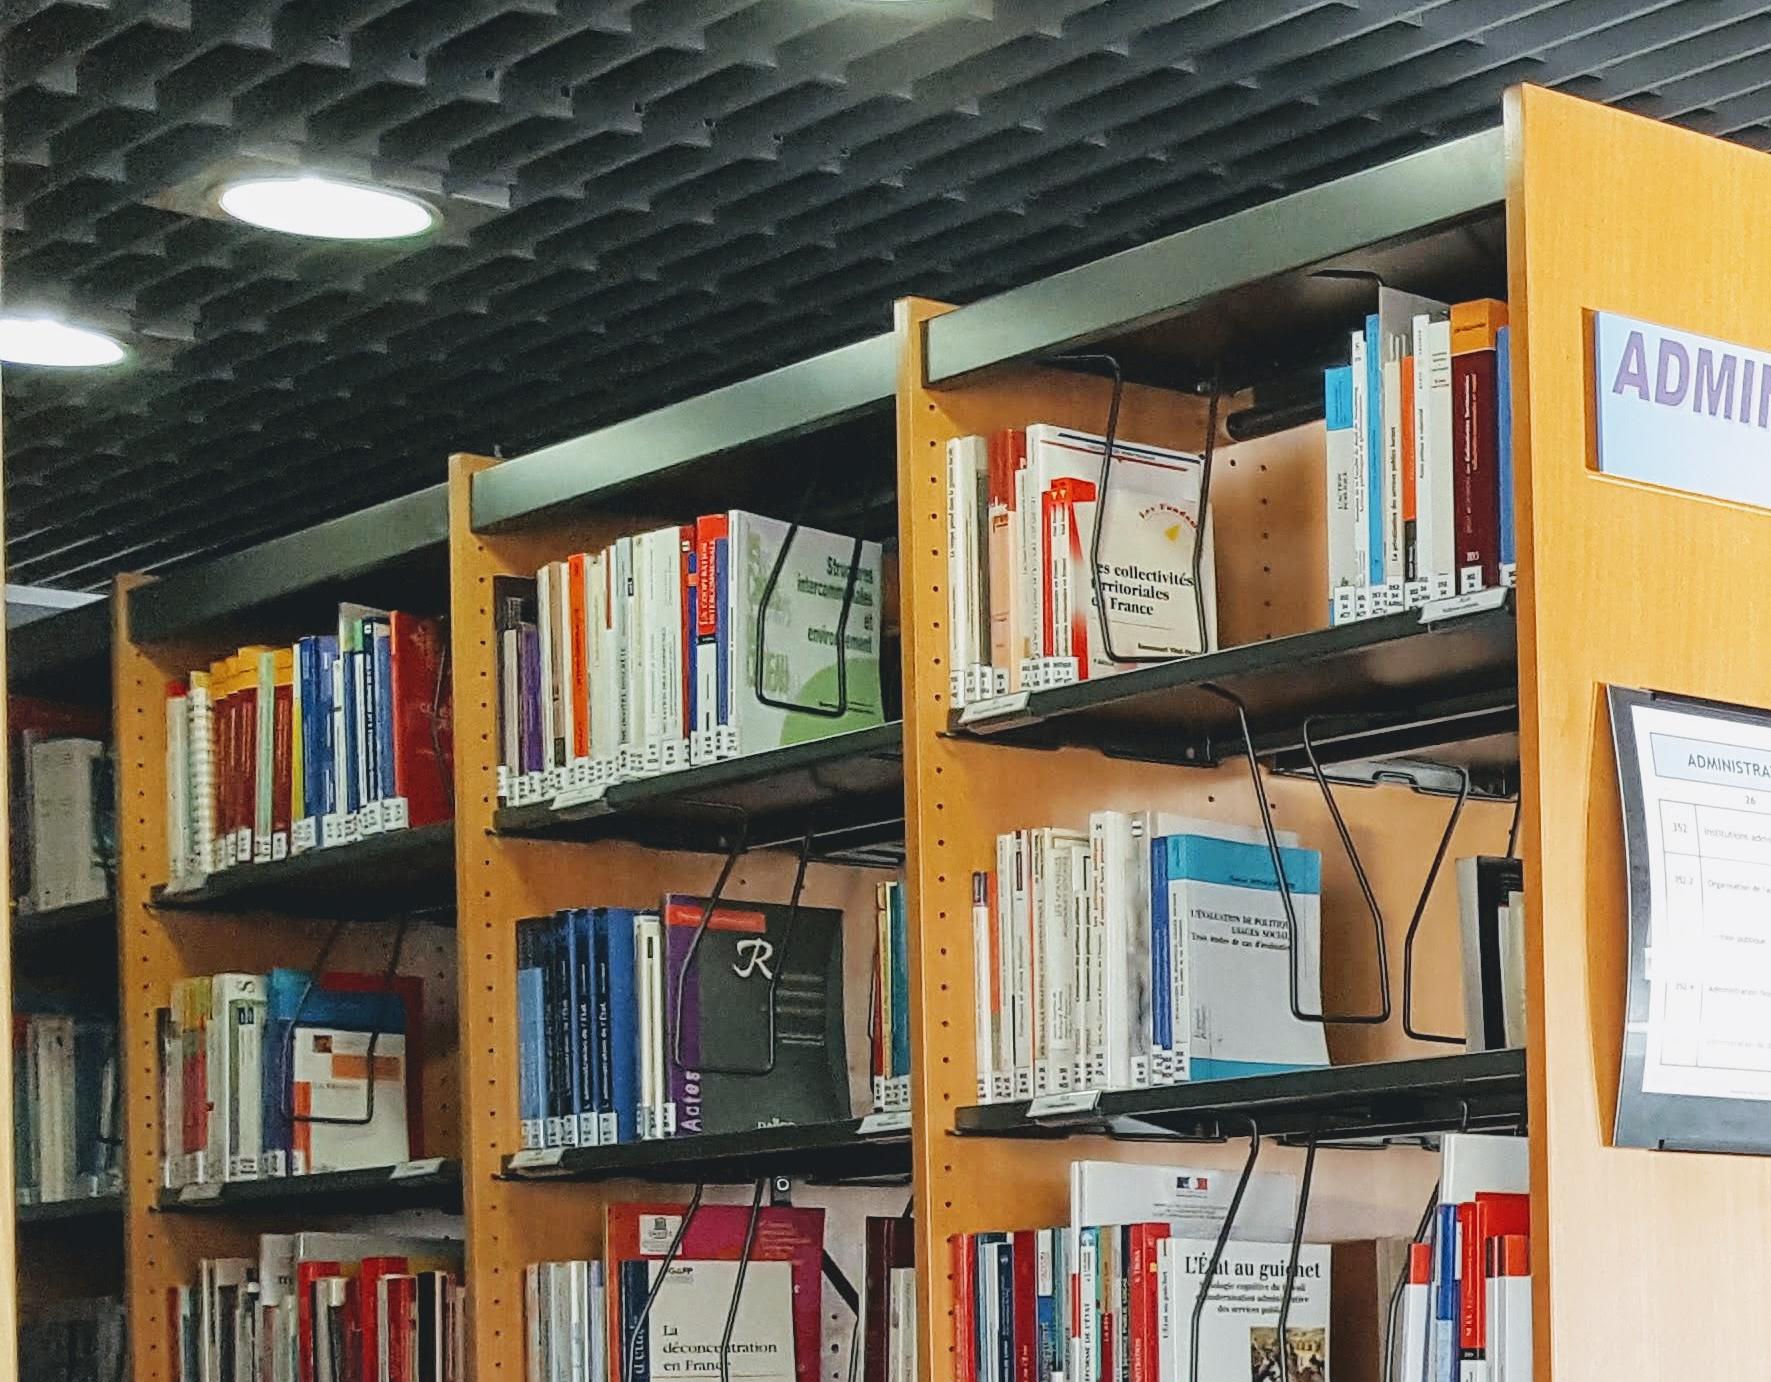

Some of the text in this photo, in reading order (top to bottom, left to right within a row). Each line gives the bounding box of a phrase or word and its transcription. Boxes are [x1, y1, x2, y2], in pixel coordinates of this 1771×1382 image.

[1114, 565, 1194, 587] collectivités
[1091, 578, 1170, 601] rritoriales
[1110, 597, 1154, 615] France
[680, 1069, 701, 1133] Actes
[1235, 1262, 1254, 1276] au
[663, 1325, 678, 1336] La
[663, 1361, 681, 1372] en
